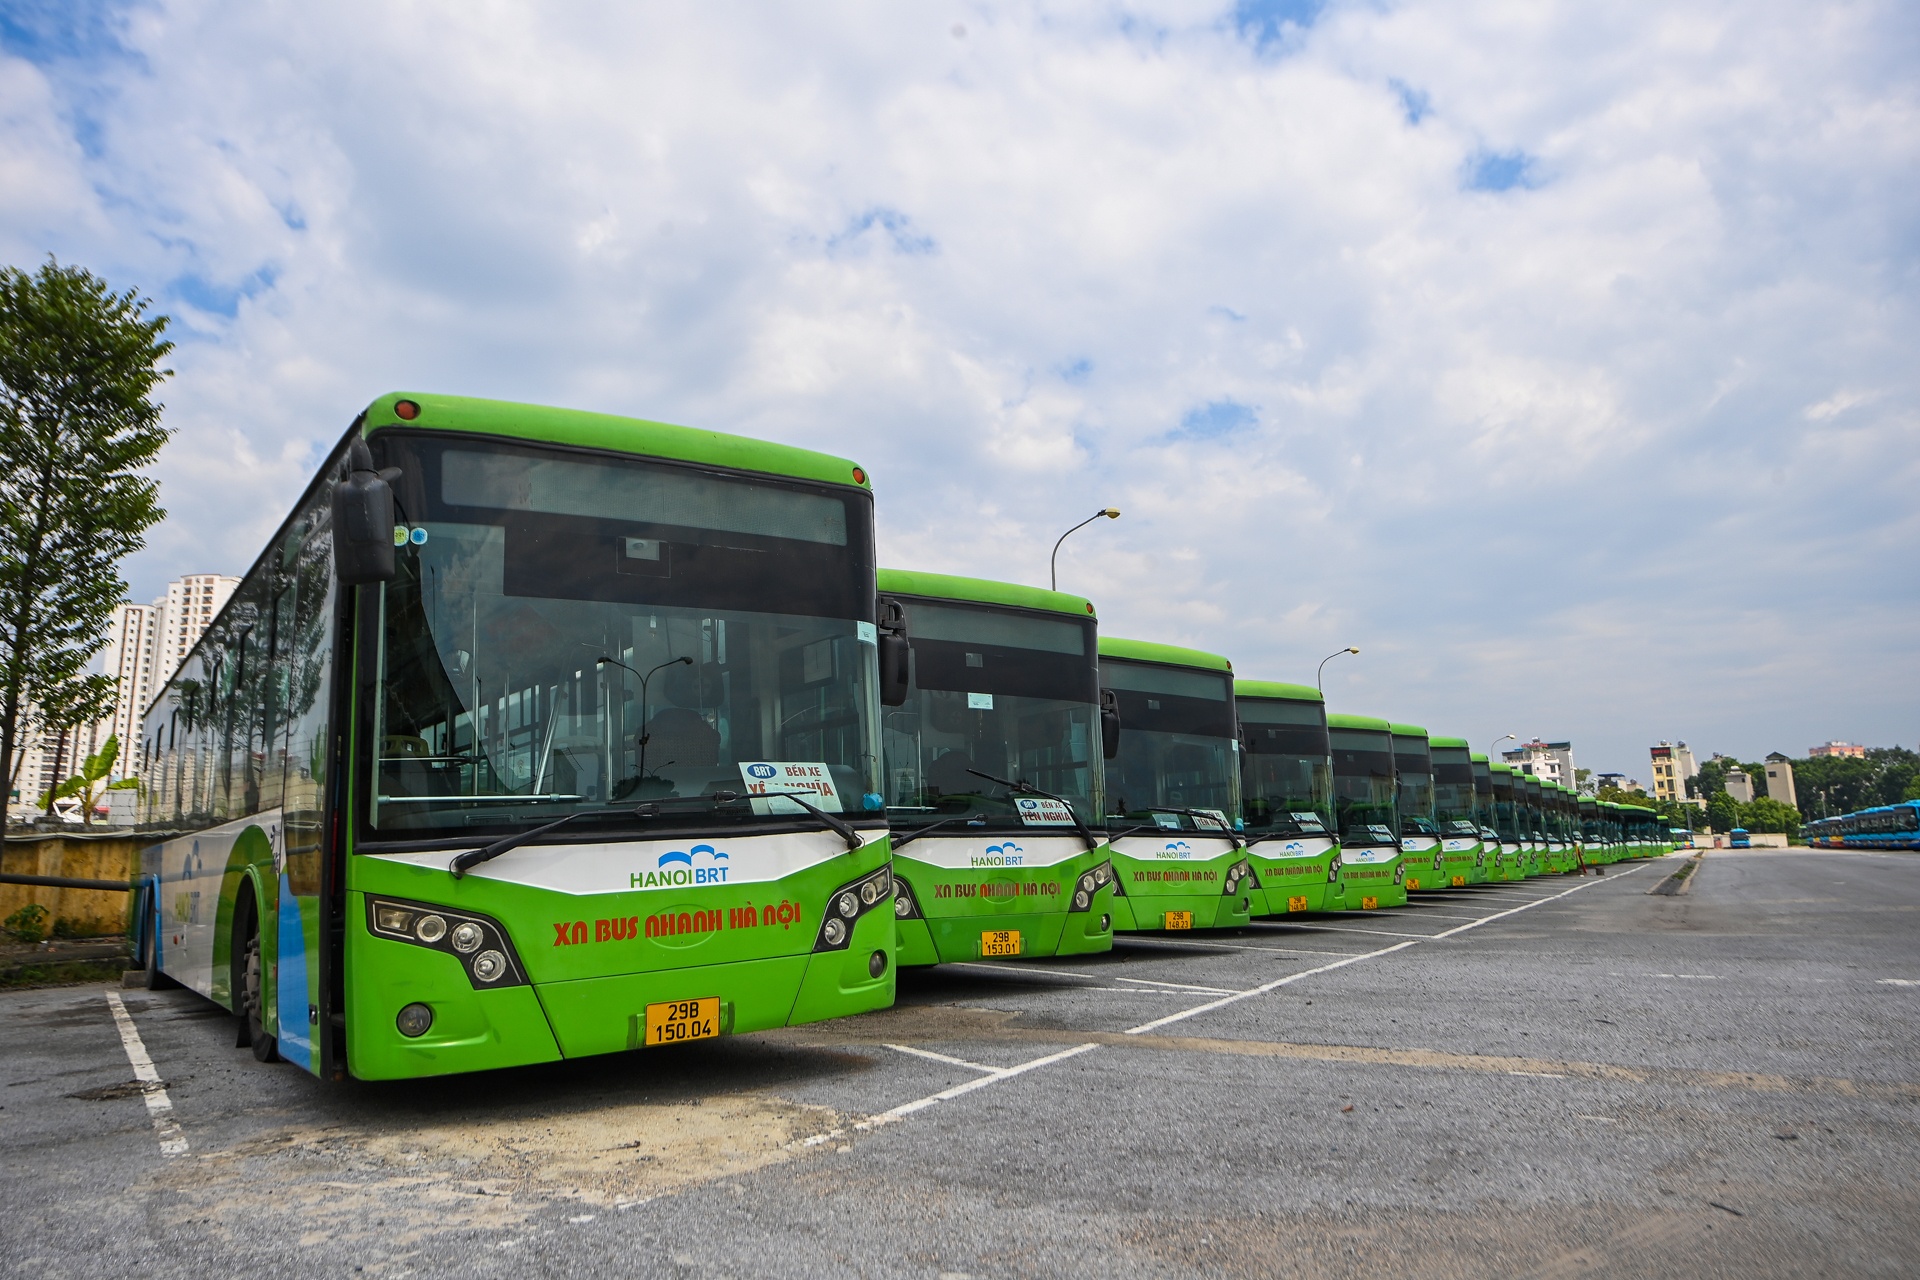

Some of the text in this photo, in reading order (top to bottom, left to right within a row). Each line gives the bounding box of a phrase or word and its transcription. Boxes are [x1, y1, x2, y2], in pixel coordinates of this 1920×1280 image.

[752, 766, 772, 777] BRT
[784, 763, 822, 777] BẾN XE
[1021, 809, 1072, 821] YÊN NGHĨA
[1146, 871, 1162, 882] BUS
[1192, 869, 1202, 882] HÀ
[1203, 869, 1218, 884] NỘI
[934, 879, 1062, 899] XN BUS NHANH HÀ NỘI
[1172, 912, 1184, 920] 29B
[553, 899, 801, 947] XN BUS NHANH HÀ NỘI
[1168, 920, 1189, 929] 148.23
[993, 932, 1010, 943] 29B
[987, 944, 1016, 955] 153.01
[668, 1001, 699, 1022] 29B
[656, 1018, 712, 1042] 150.04
